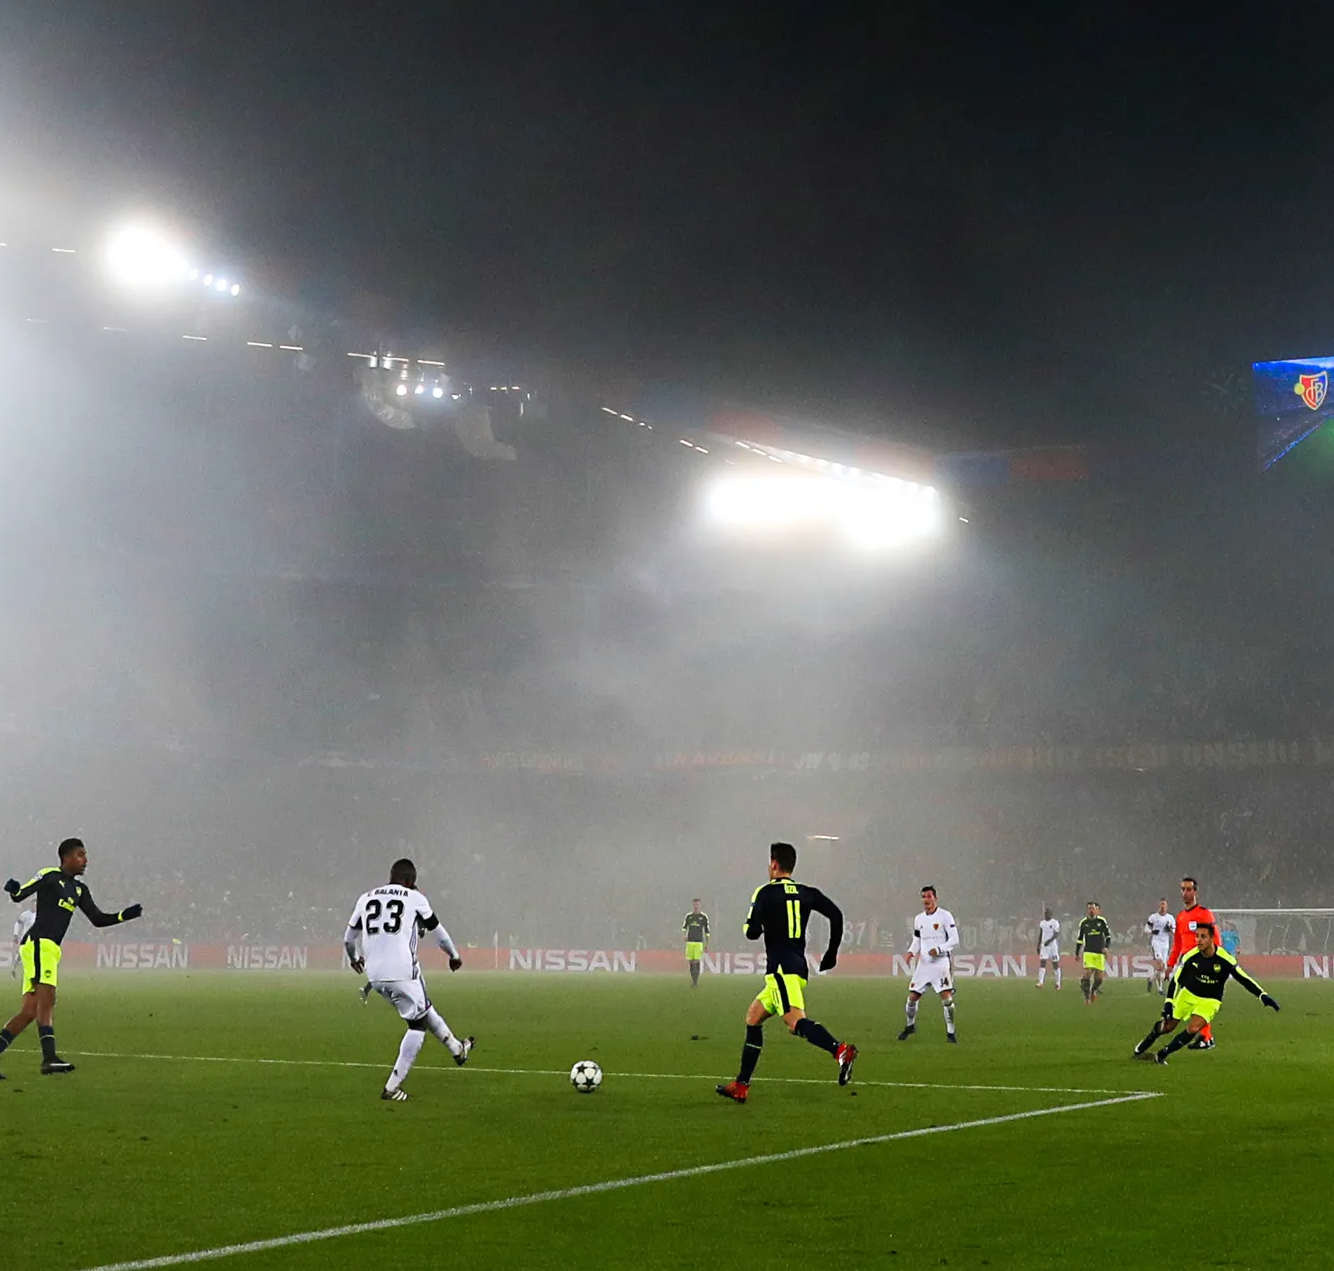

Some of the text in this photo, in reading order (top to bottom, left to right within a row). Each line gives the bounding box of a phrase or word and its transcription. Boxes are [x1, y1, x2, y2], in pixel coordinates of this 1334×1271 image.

[365, 899, 406, 936] 23
[786, 899, 802, 939] 11
[96, 944, 189, 968] NISSAN
[227, 945, 308, 969] NISSAN
[509, 949, 637, 973] NISSAN
[700, 952, 826, 974] NISN
[892, 954, 1027, 977] NSAN
